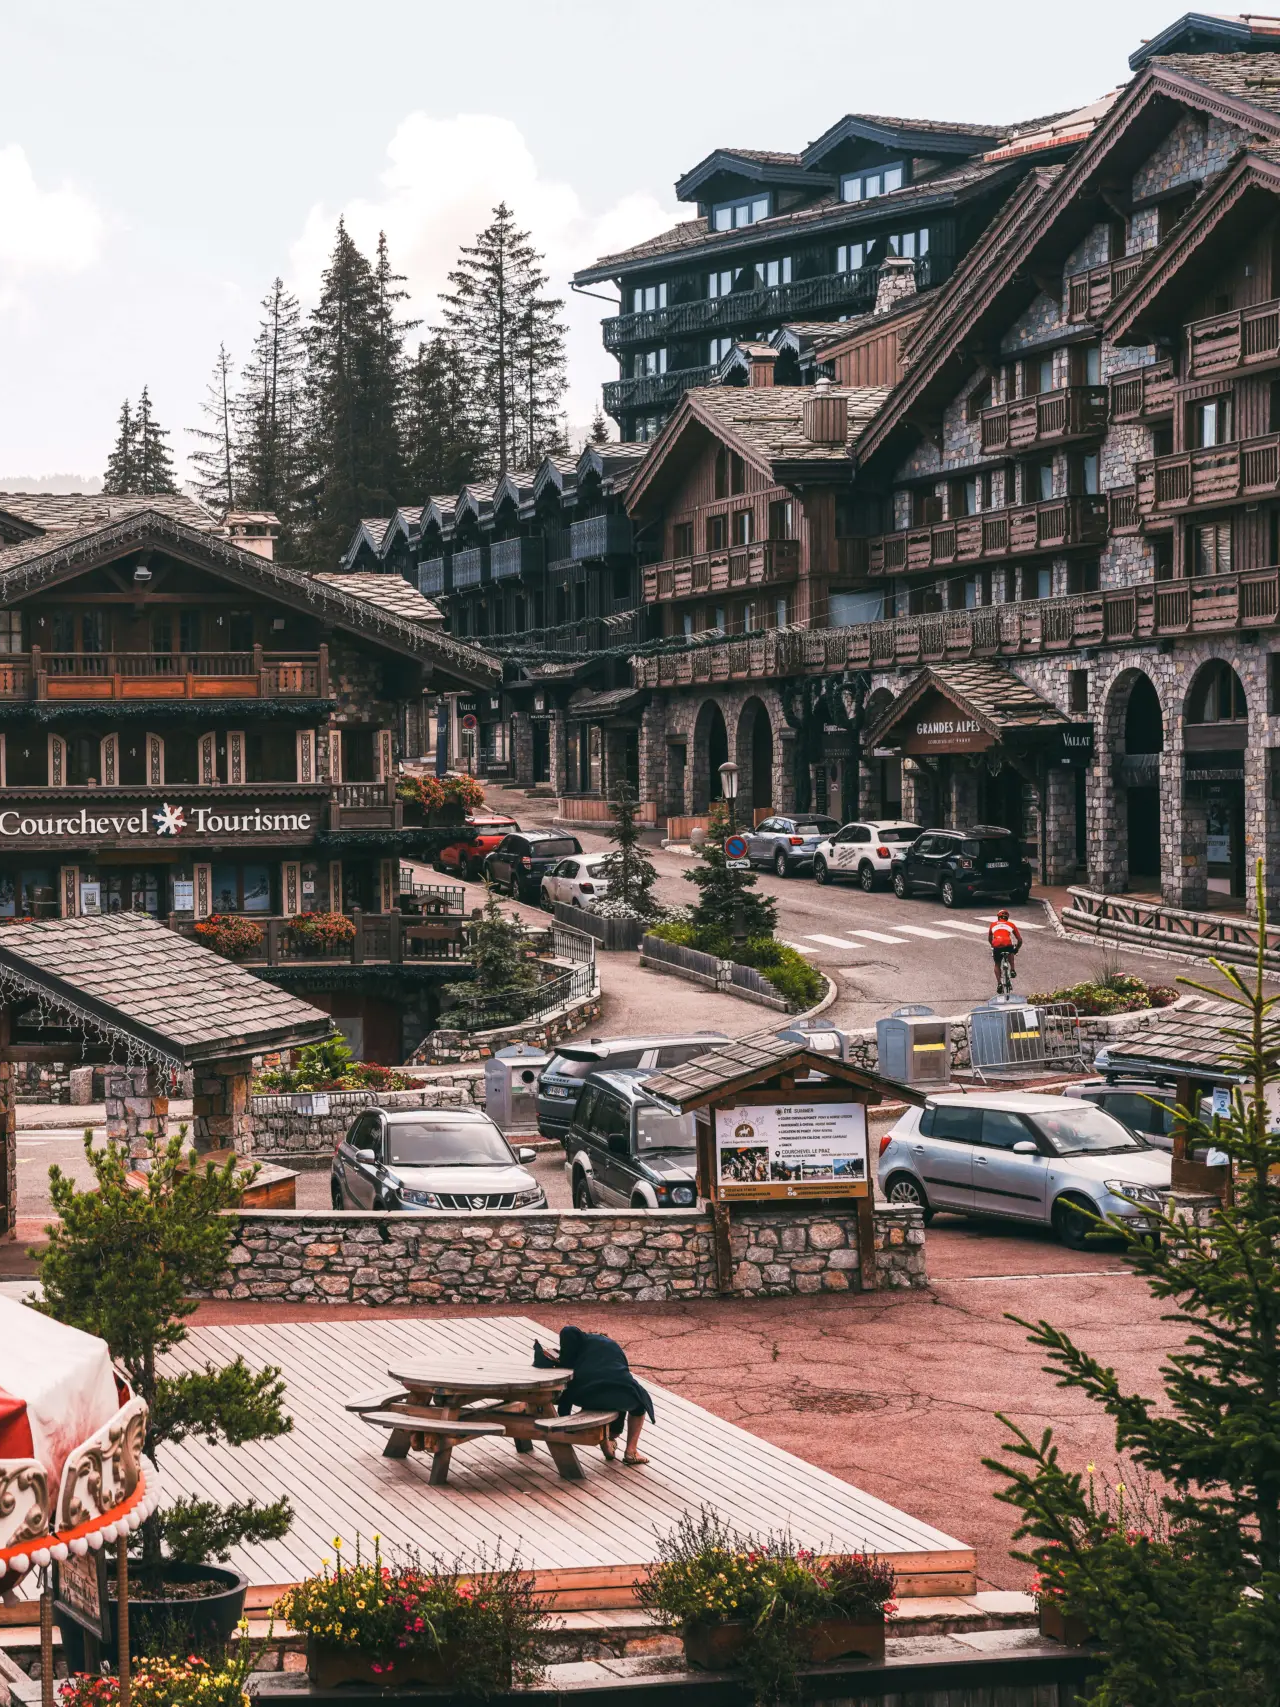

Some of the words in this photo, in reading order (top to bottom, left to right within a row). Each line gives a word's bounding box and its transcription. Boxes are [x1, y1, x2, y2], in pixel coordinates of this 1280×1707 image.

[916, 722, 954, 735] GRANDES
[956, 720, 981, 733] ALPES
[190, 807, 312, 834] Tourisme
